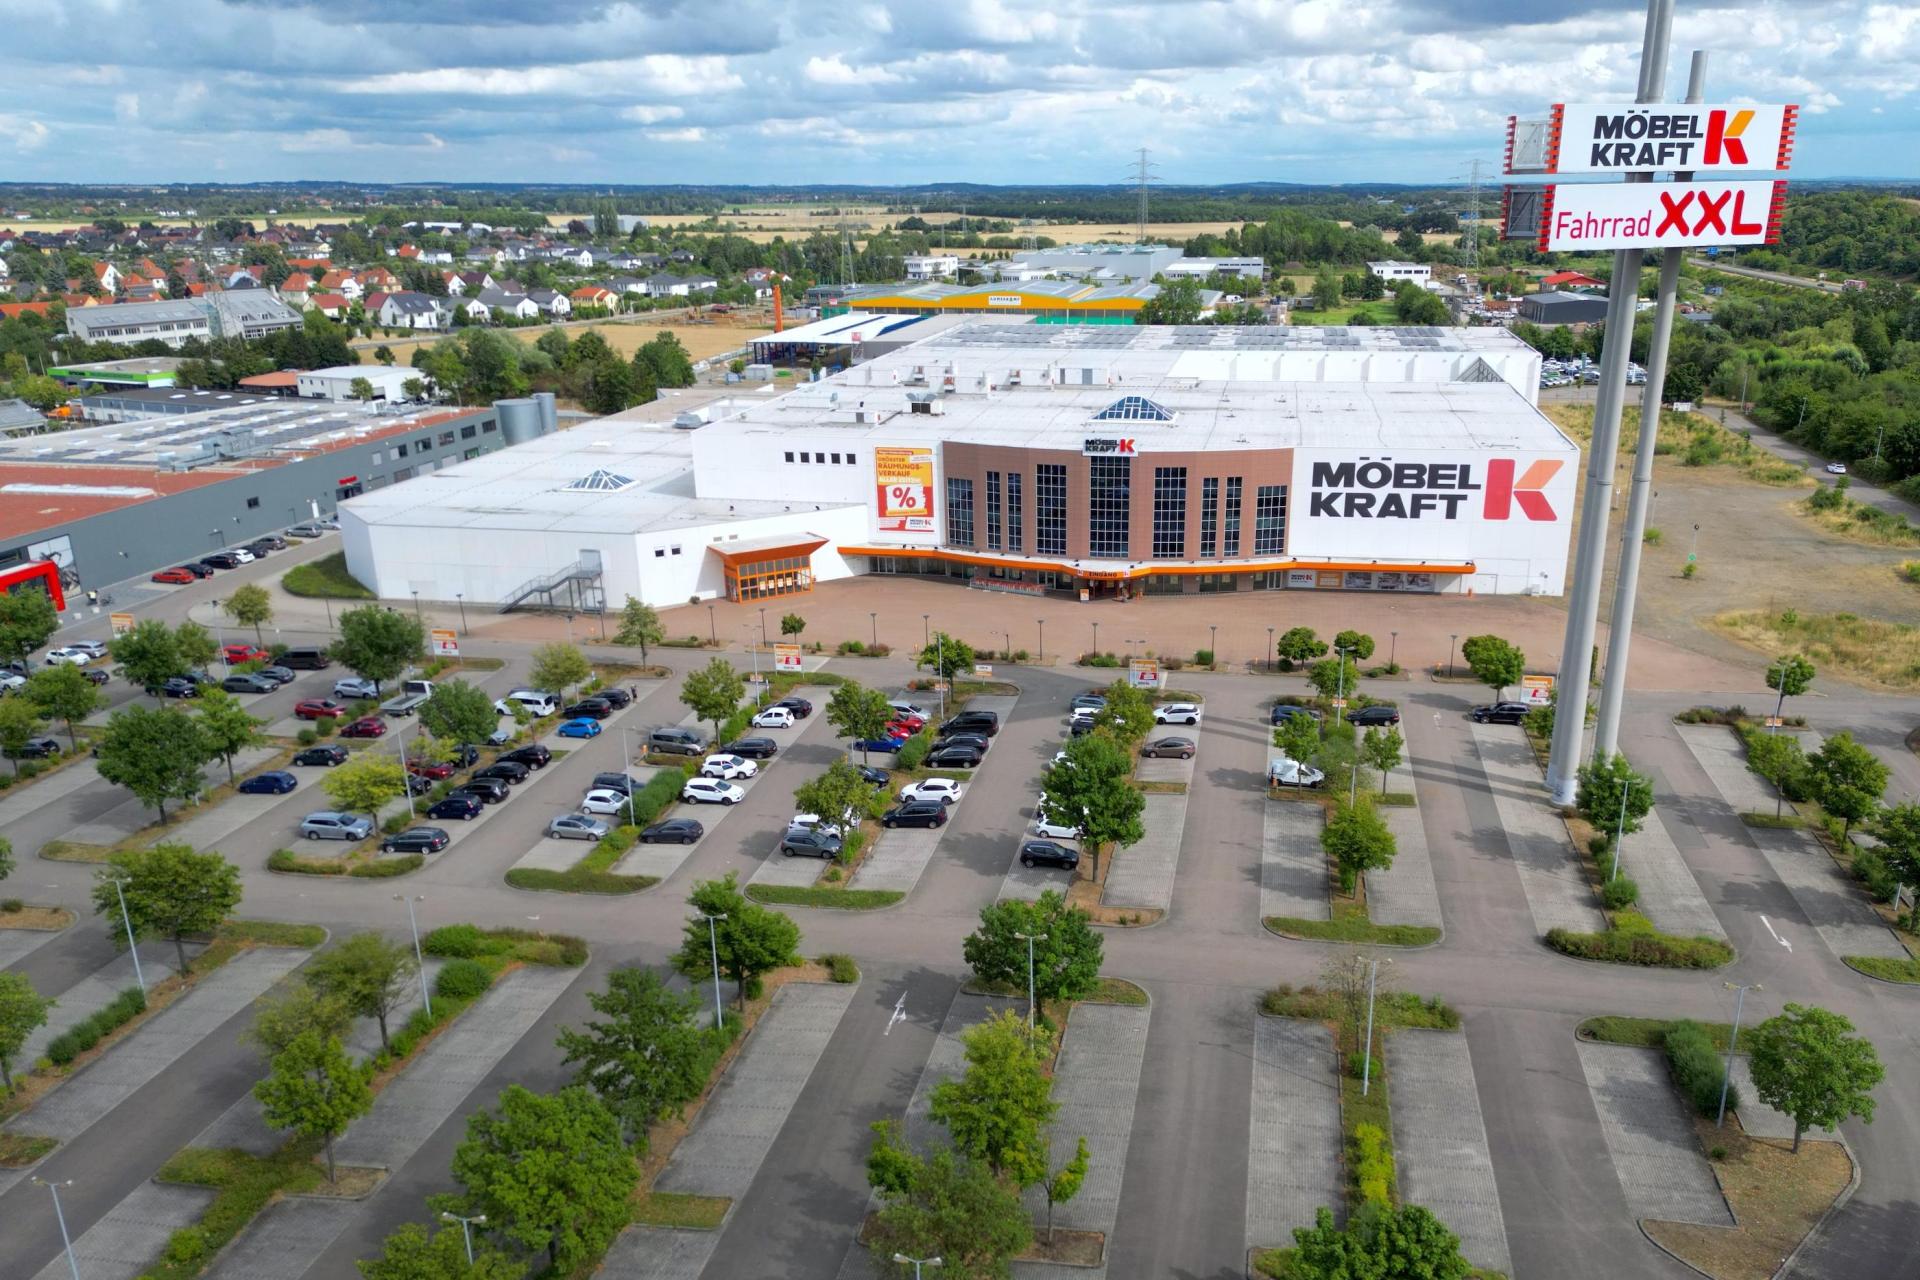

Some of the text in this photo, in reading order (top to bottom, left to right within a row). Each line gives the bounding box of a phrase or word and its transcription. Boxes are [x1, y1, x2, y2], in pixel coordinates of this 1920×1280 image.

[1593, 109, 1704, 139] MÖBEL
[1590, 142, 1694, 167] KRAFT
[1556, 190, 1762, 239] Fahrrad XXL
[1085, 438, 1119, 446] MÖBEL
[1311, 456, 1482, 490] MÖBEL
[893, 487, 916, 508] %
[1310, 491, 1468, 520] KRAFT
